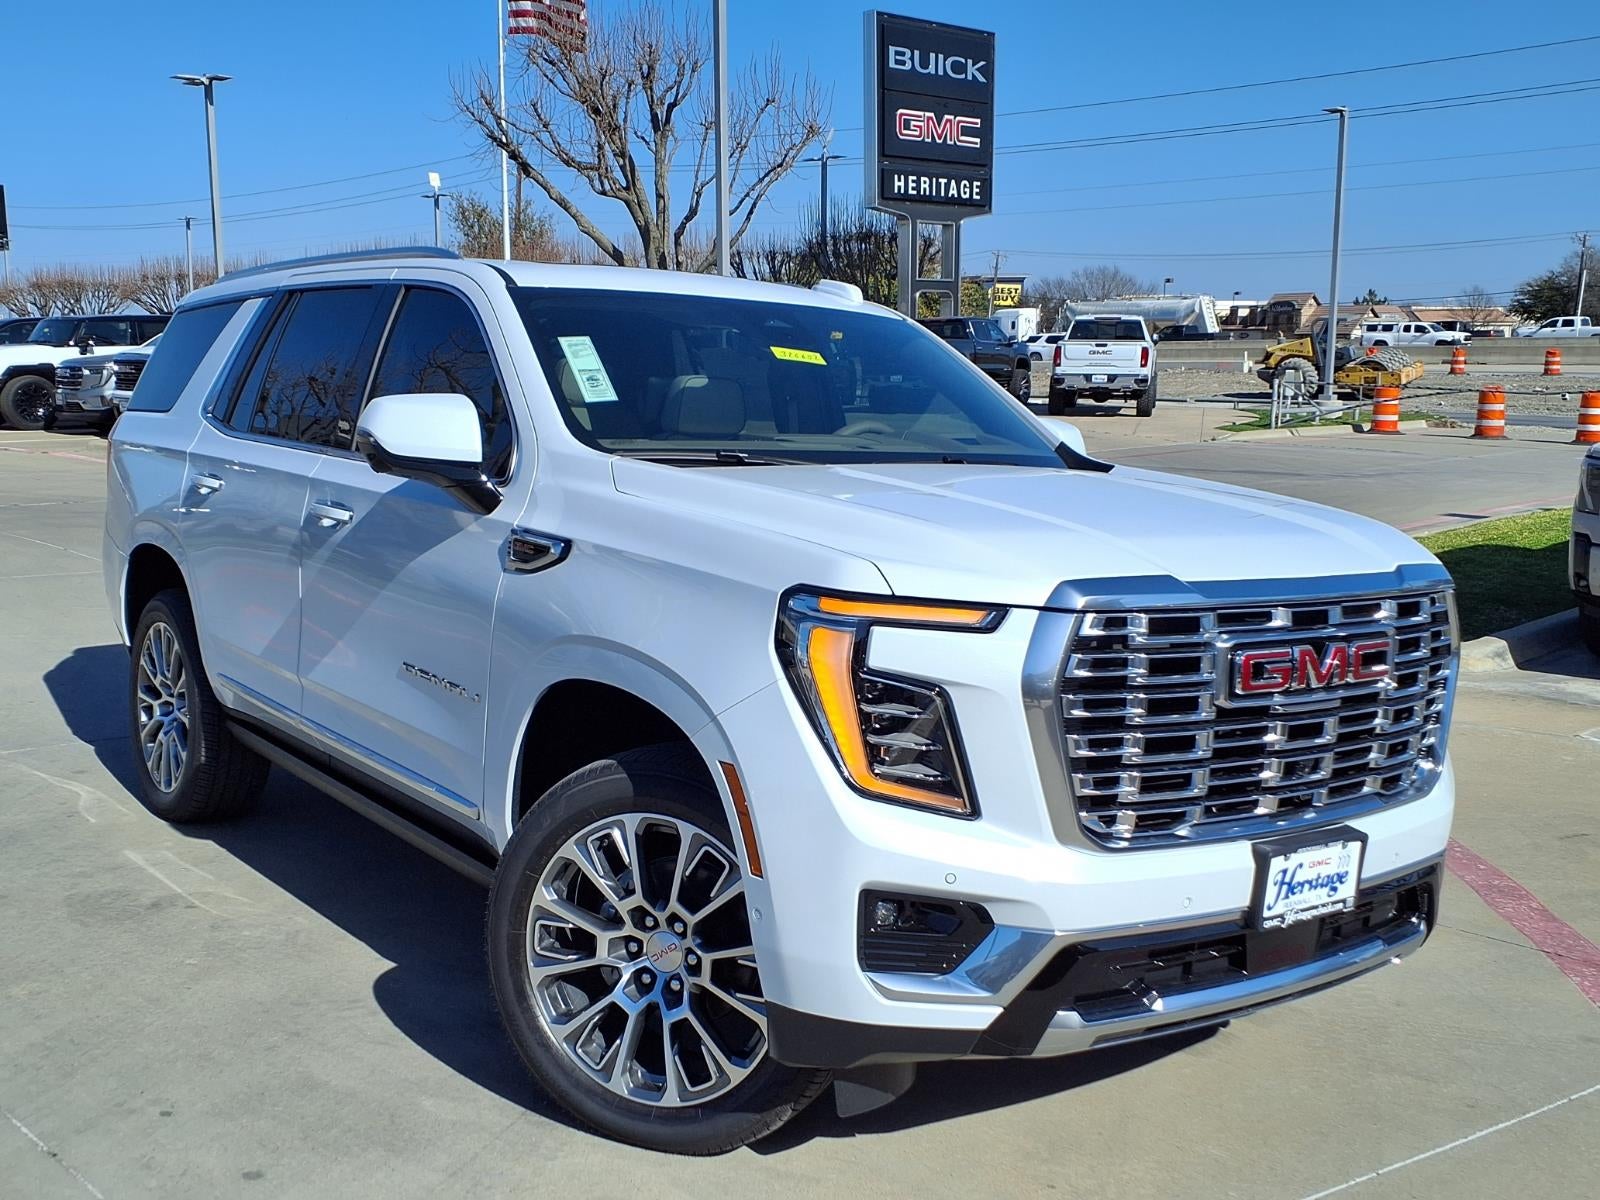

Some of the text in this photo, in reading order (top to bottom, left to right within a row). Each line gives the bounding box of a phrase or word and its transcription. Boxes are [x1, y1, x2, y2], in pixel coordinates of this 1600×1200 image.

[888, 44, 988, 83] BUICK
[896, 108, 981, 148] GMC
[893, 173, 981, 200] HERITAGE
[994, 287, 1020, 295] BEST
[994, 294, 1017, 304] BUY
[1235, 640, 1392, 694] GMC
[1308, 857, 1334, 869] GMC
[1266, 862, 1349, 912] Heritage
[650, 942, 678, 962] GMC
